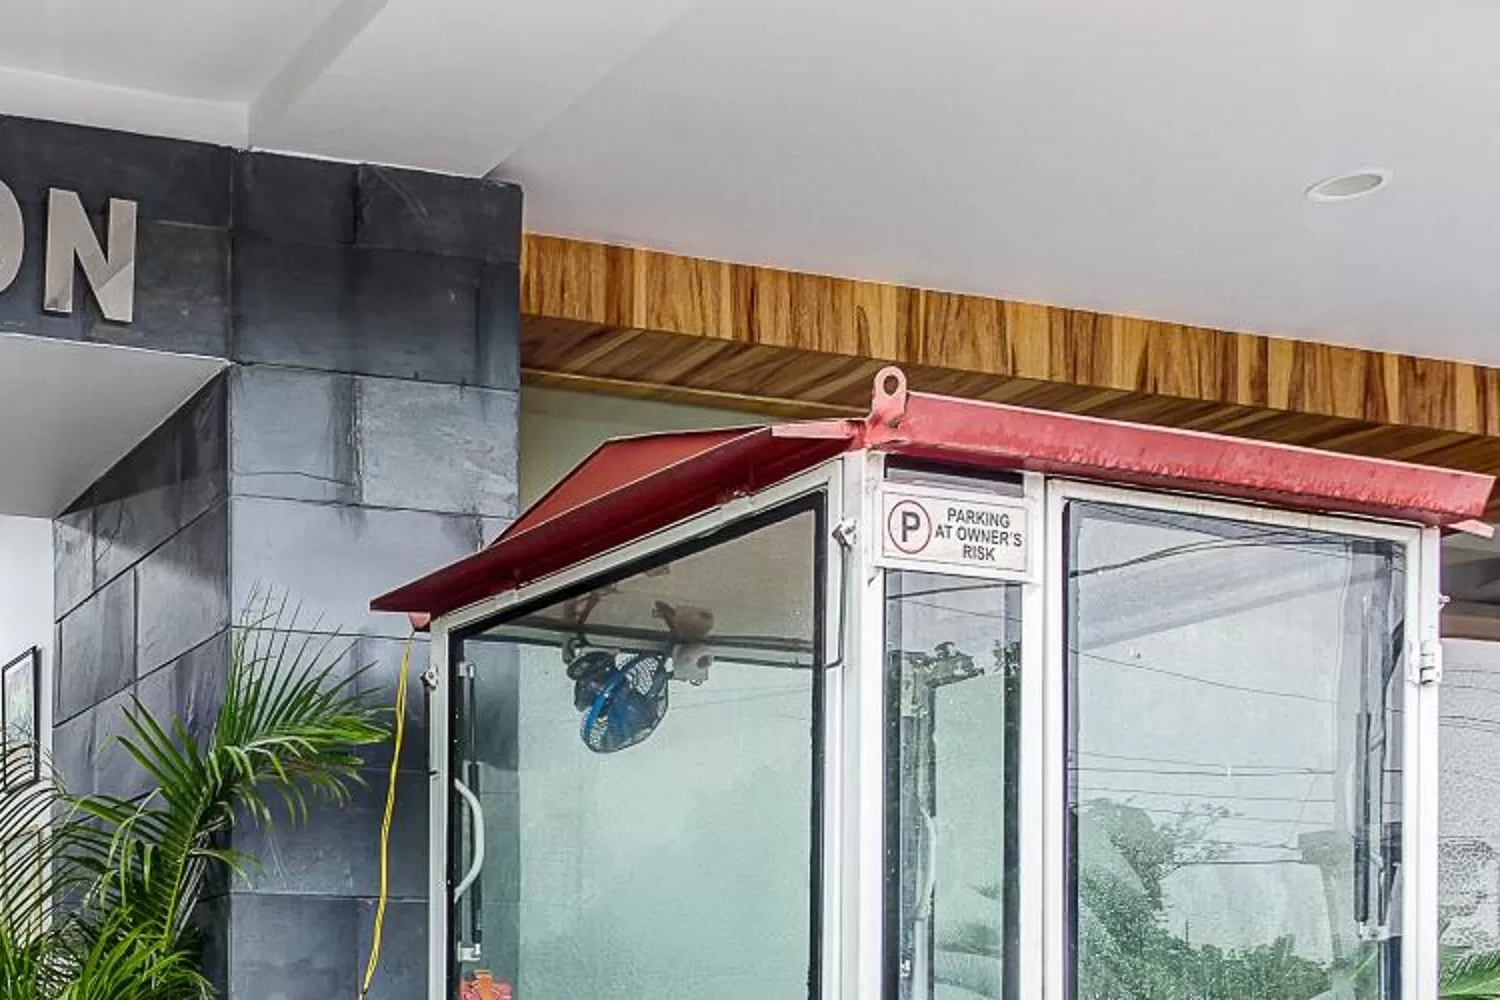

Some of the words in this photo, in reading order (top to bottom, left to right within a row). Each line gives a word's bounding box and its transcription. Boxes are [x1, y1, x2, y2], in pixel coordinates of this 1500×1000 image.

[901, 511, 921, 543] P
[947, 507, 1011, 529] PARKING
[935, 525, 954, 540] AT
[956, 526, 1023, 547] OWNER'S
[963, 545, 996, 562] RISK
